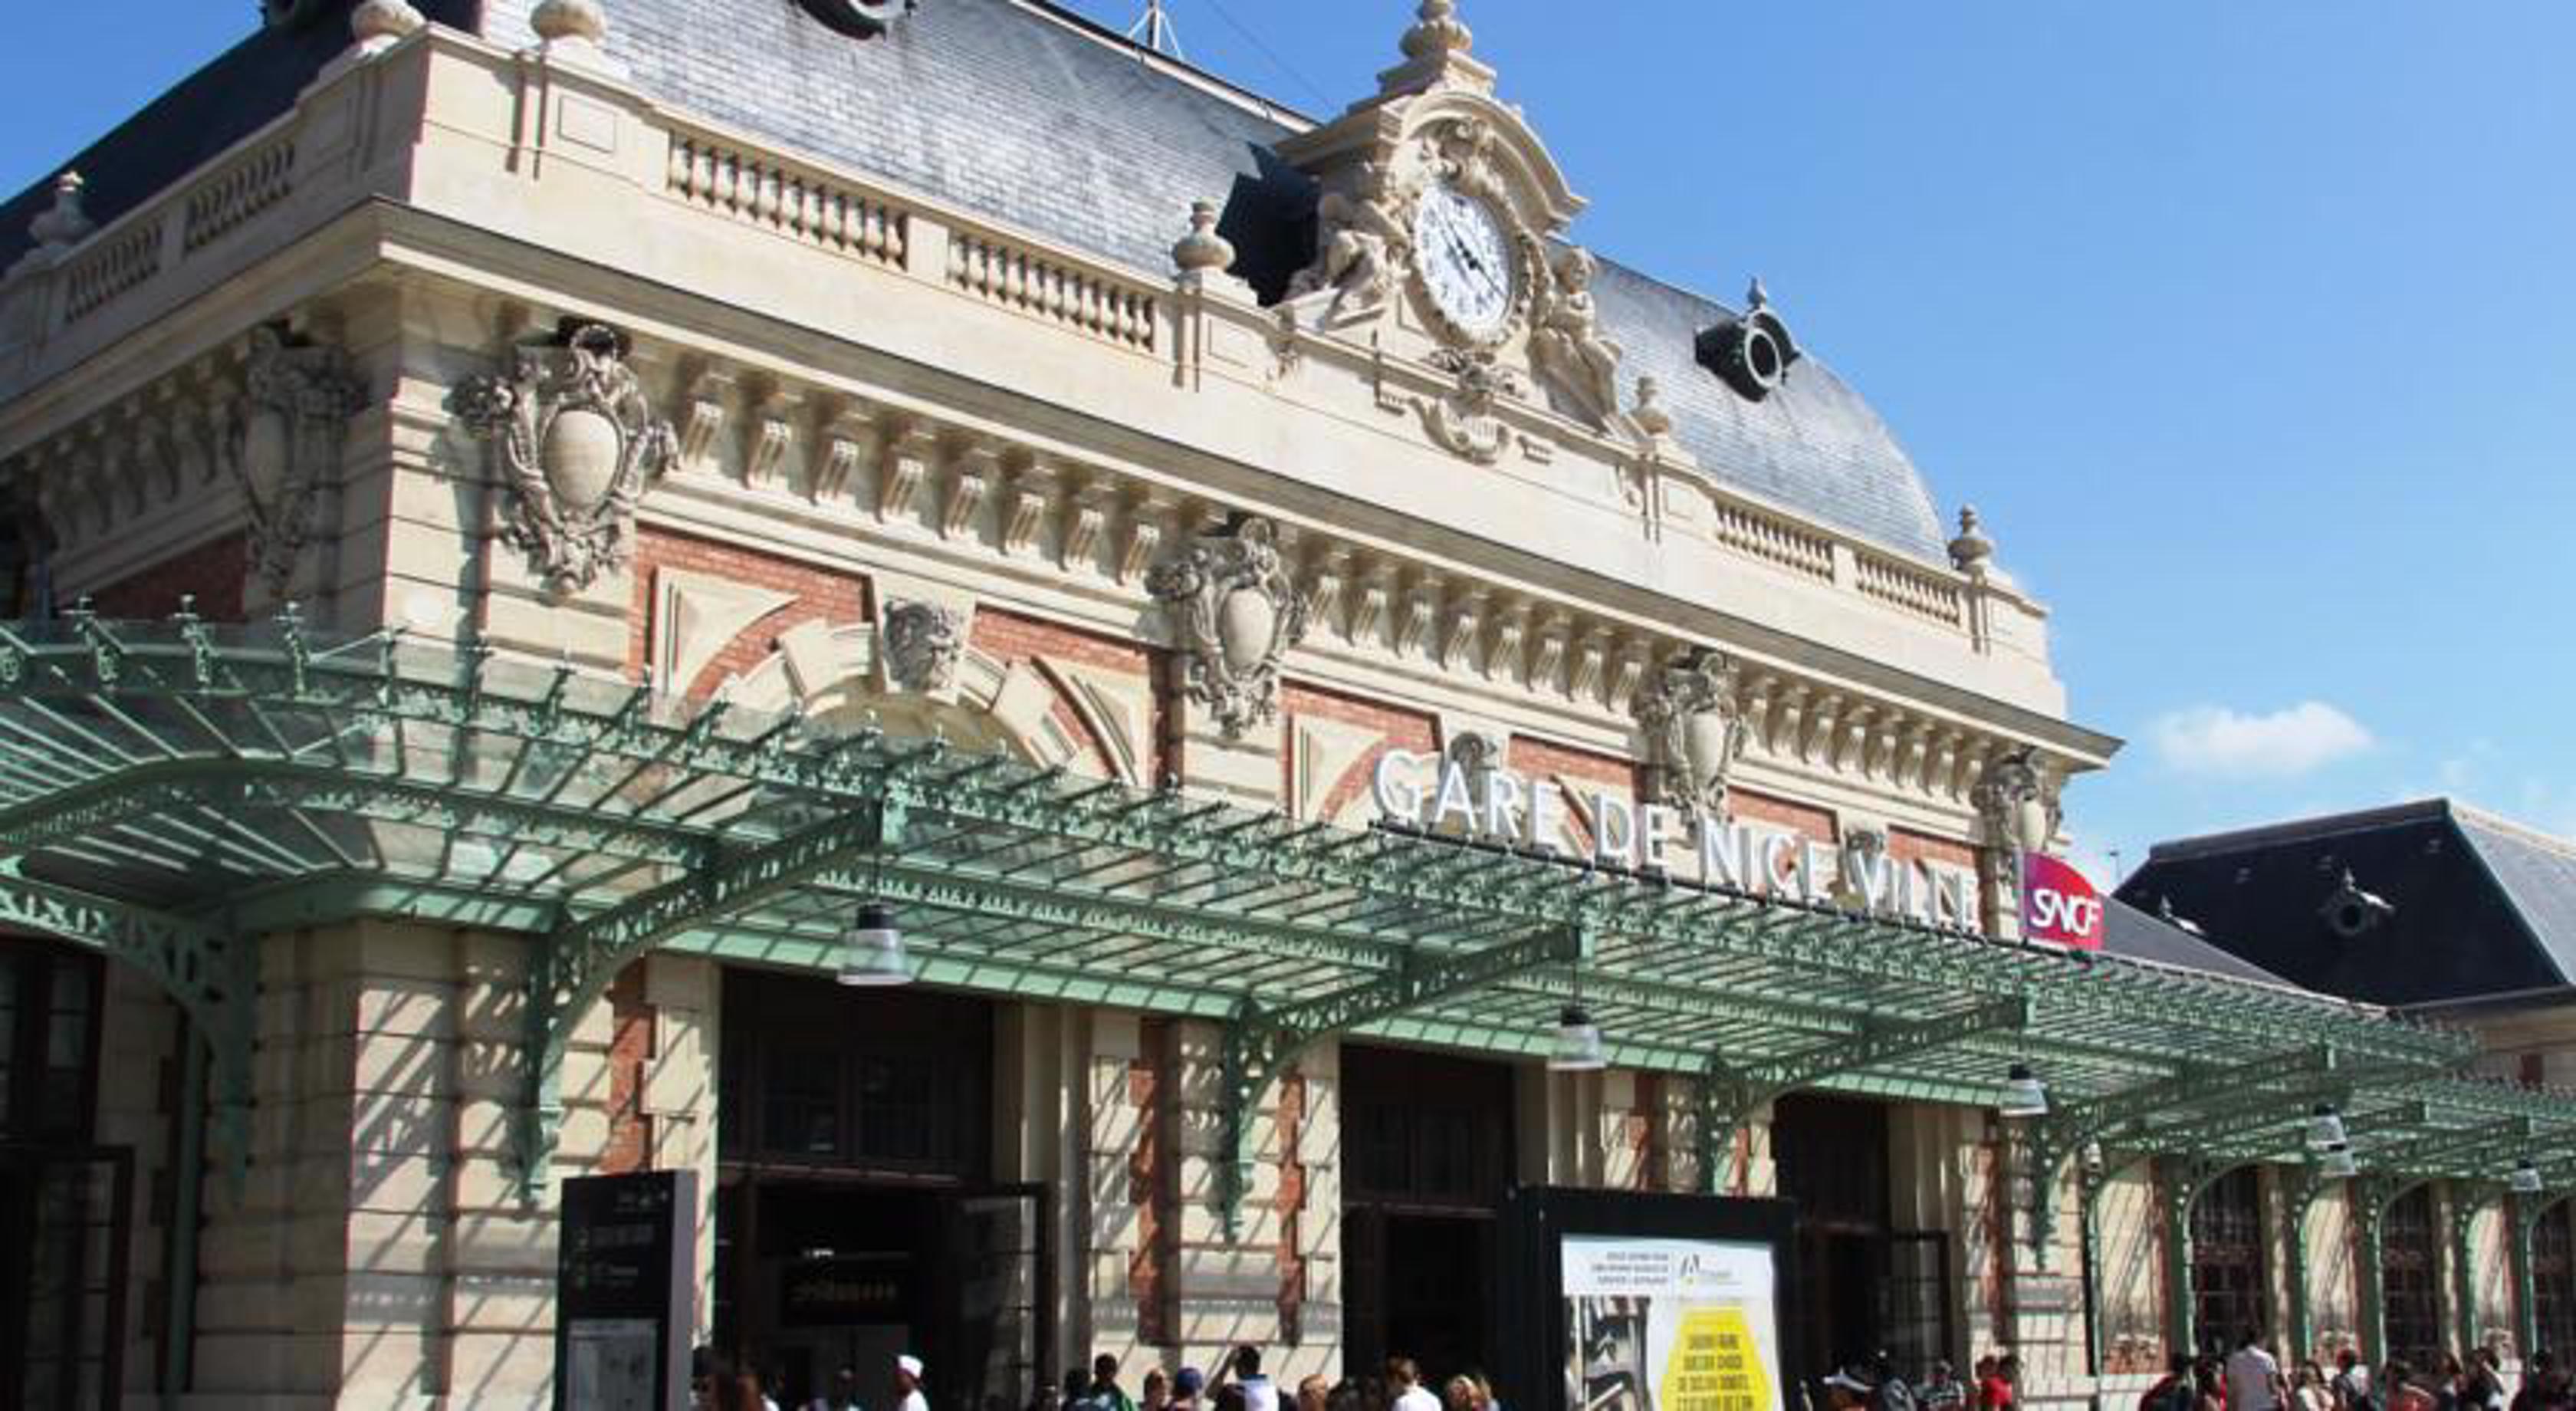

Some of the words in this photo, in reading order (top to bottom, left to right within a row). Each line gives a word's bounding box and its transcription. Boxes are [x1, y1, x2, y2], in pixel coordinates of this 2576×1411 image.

[1375, 748, 1562, 845] GARE
[1592, 794, 1676, 866] DE
[1699, 816, 1834, 900] NICE
[1846, 848, 1983, 934] VILLE
[2030, 888, 2101, 937] SNCF
